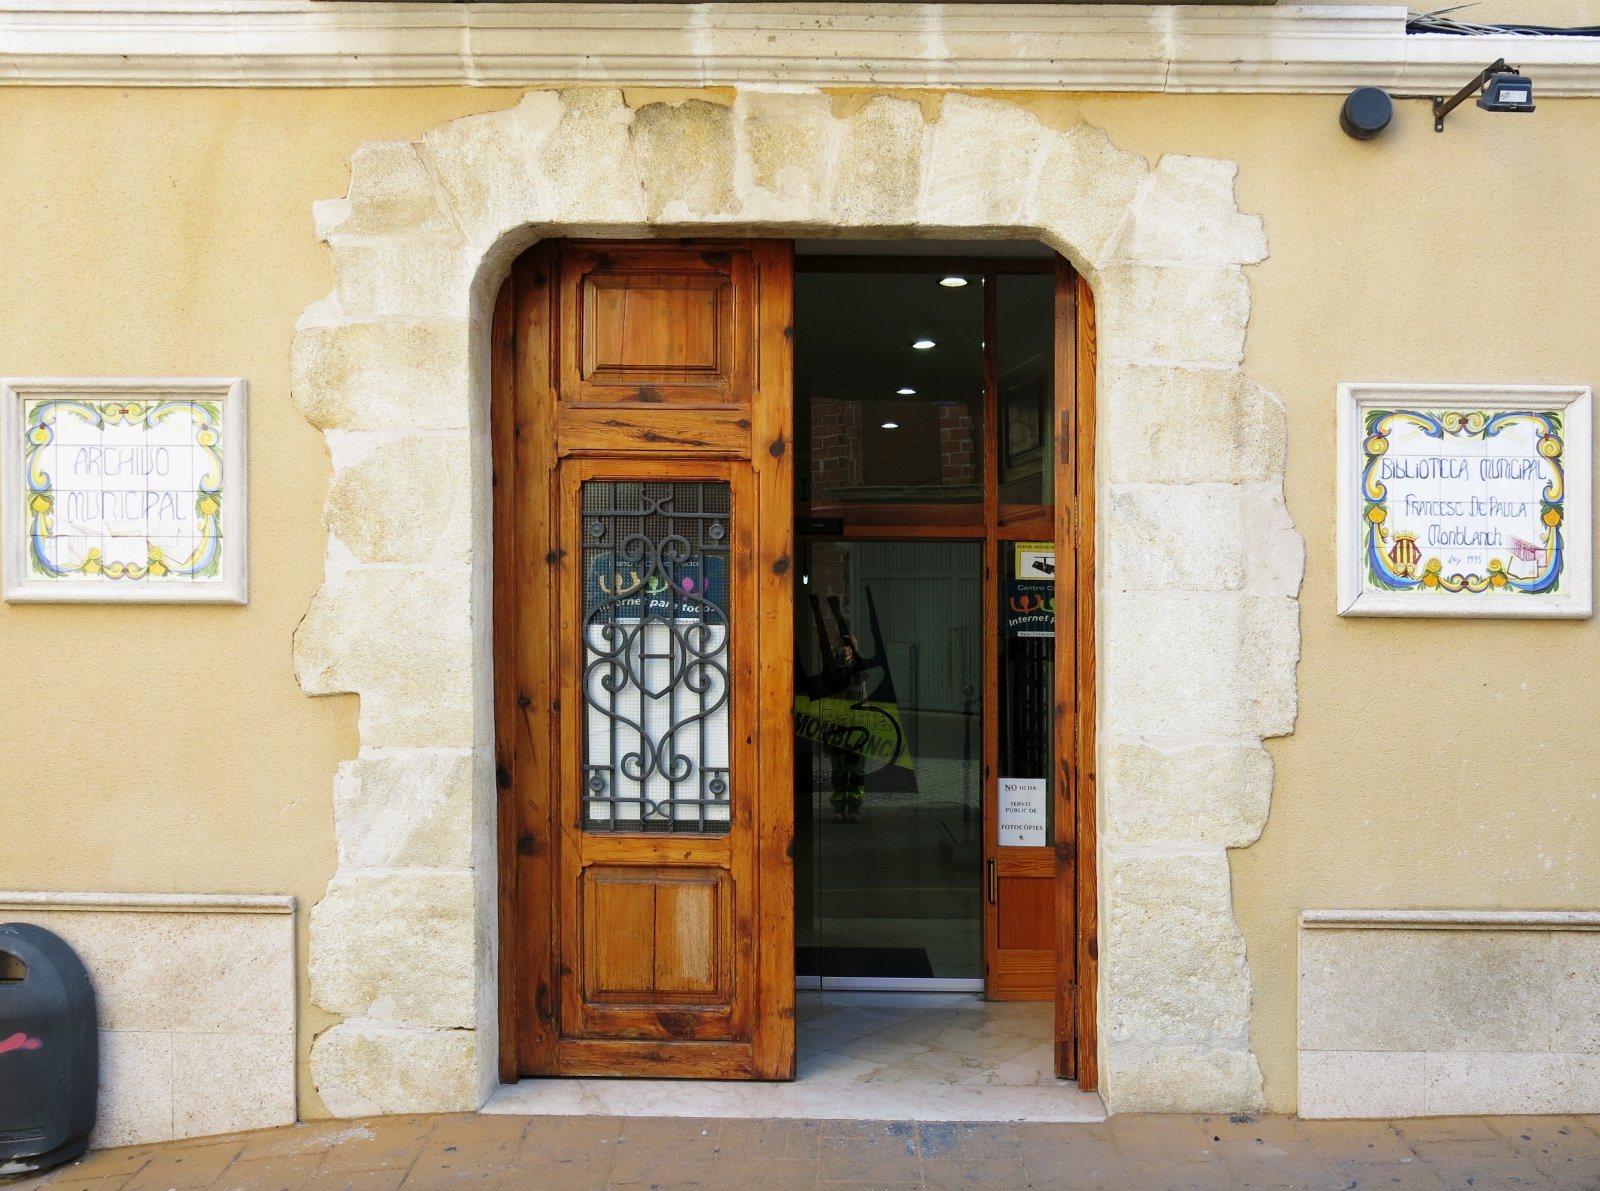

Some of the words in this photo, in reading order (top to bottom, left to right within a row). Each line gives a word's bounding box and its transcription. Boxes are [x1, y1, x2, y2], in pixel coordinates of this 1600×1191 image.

[73, 446, 170, 477] ARCHIVO
[1479, 457, 1548, 481] MUNICIPAL
[66, 491, 187, 523] MUNICIPAL
[1405, 493, 1464, 517] FRANCESC
[1488, 497, 1528, 517] PAULA
[1008, 614, 1049, 627] Internet
